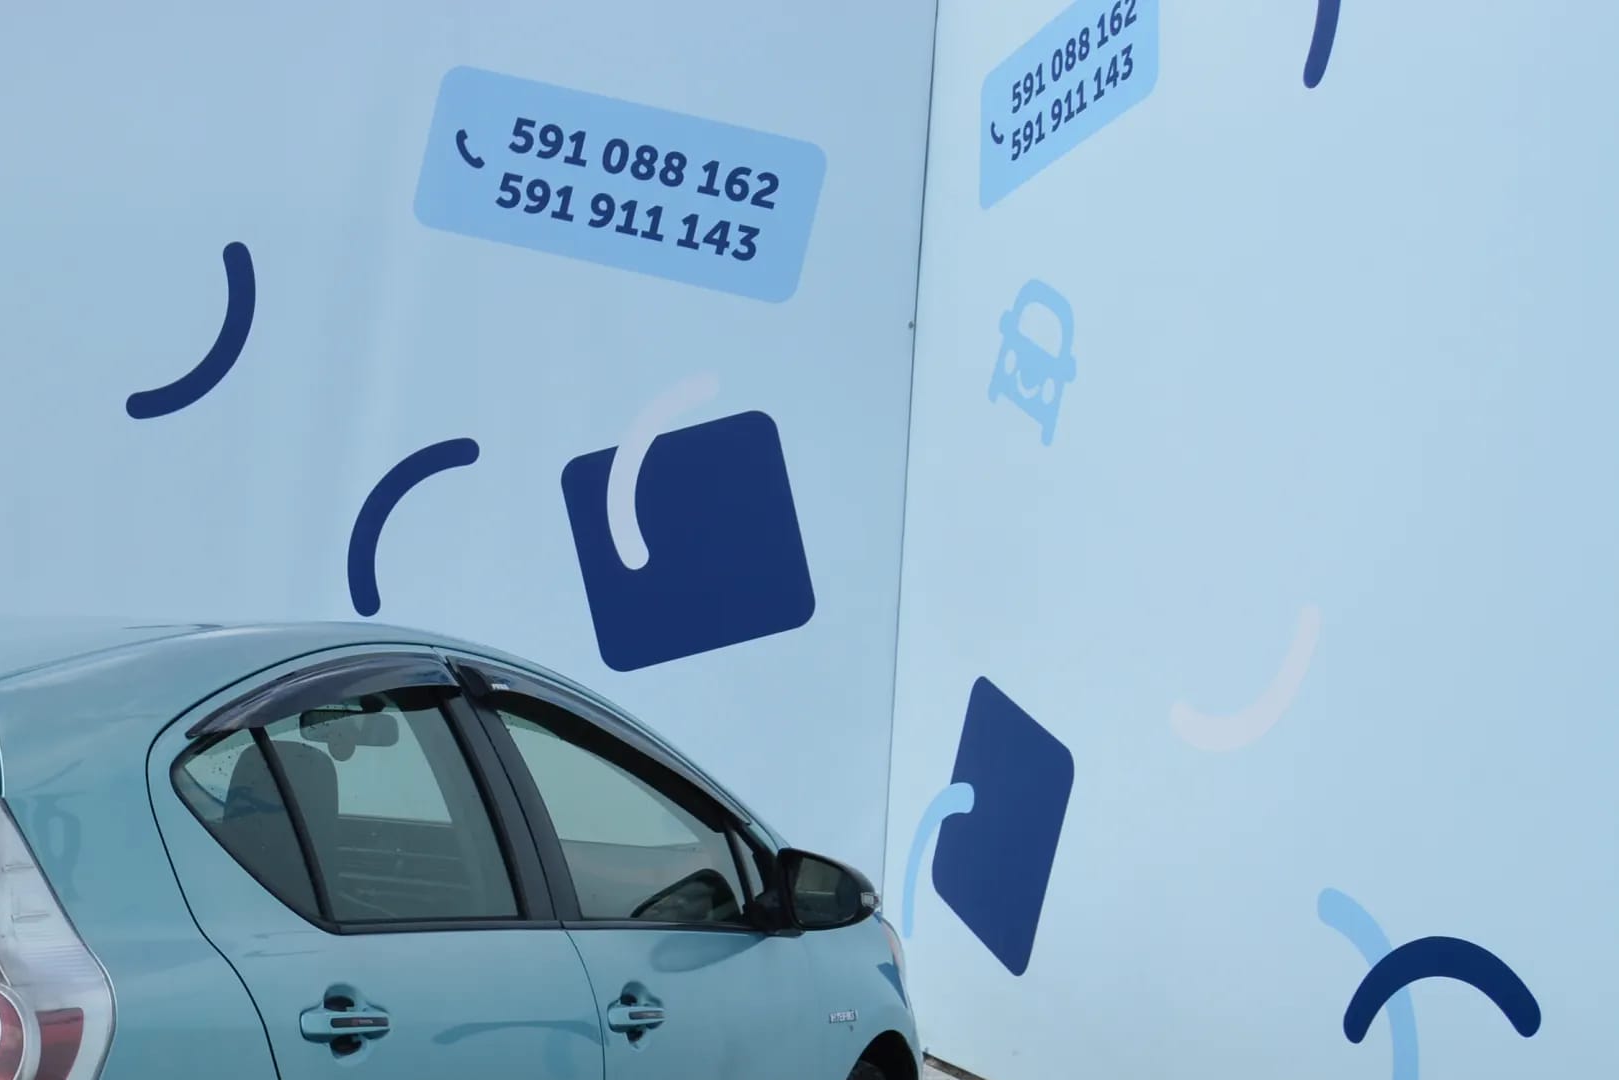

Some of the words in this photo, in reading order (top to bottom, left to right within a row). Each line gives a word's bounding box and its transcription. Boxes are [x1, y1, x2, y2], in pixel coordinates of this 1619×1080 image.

[1011, 63, 1046, 114] 591
[1051, 27, 1090, 82] 088
[1097, 0, 1137, 49] 162
[1011, 111, 1045, 161] 591
[1051, 80, 1087, 132] 911
[1093, 43, 1133, 101] 143
[508, 117, 588, 167] 591
[601, 138, 687, 187] 088
[697, 160, 779, 209] 162
[495, 172, 575, 222] 591
[587, 193, 664, 242] 911
[676, 213, 760, 261] 143
